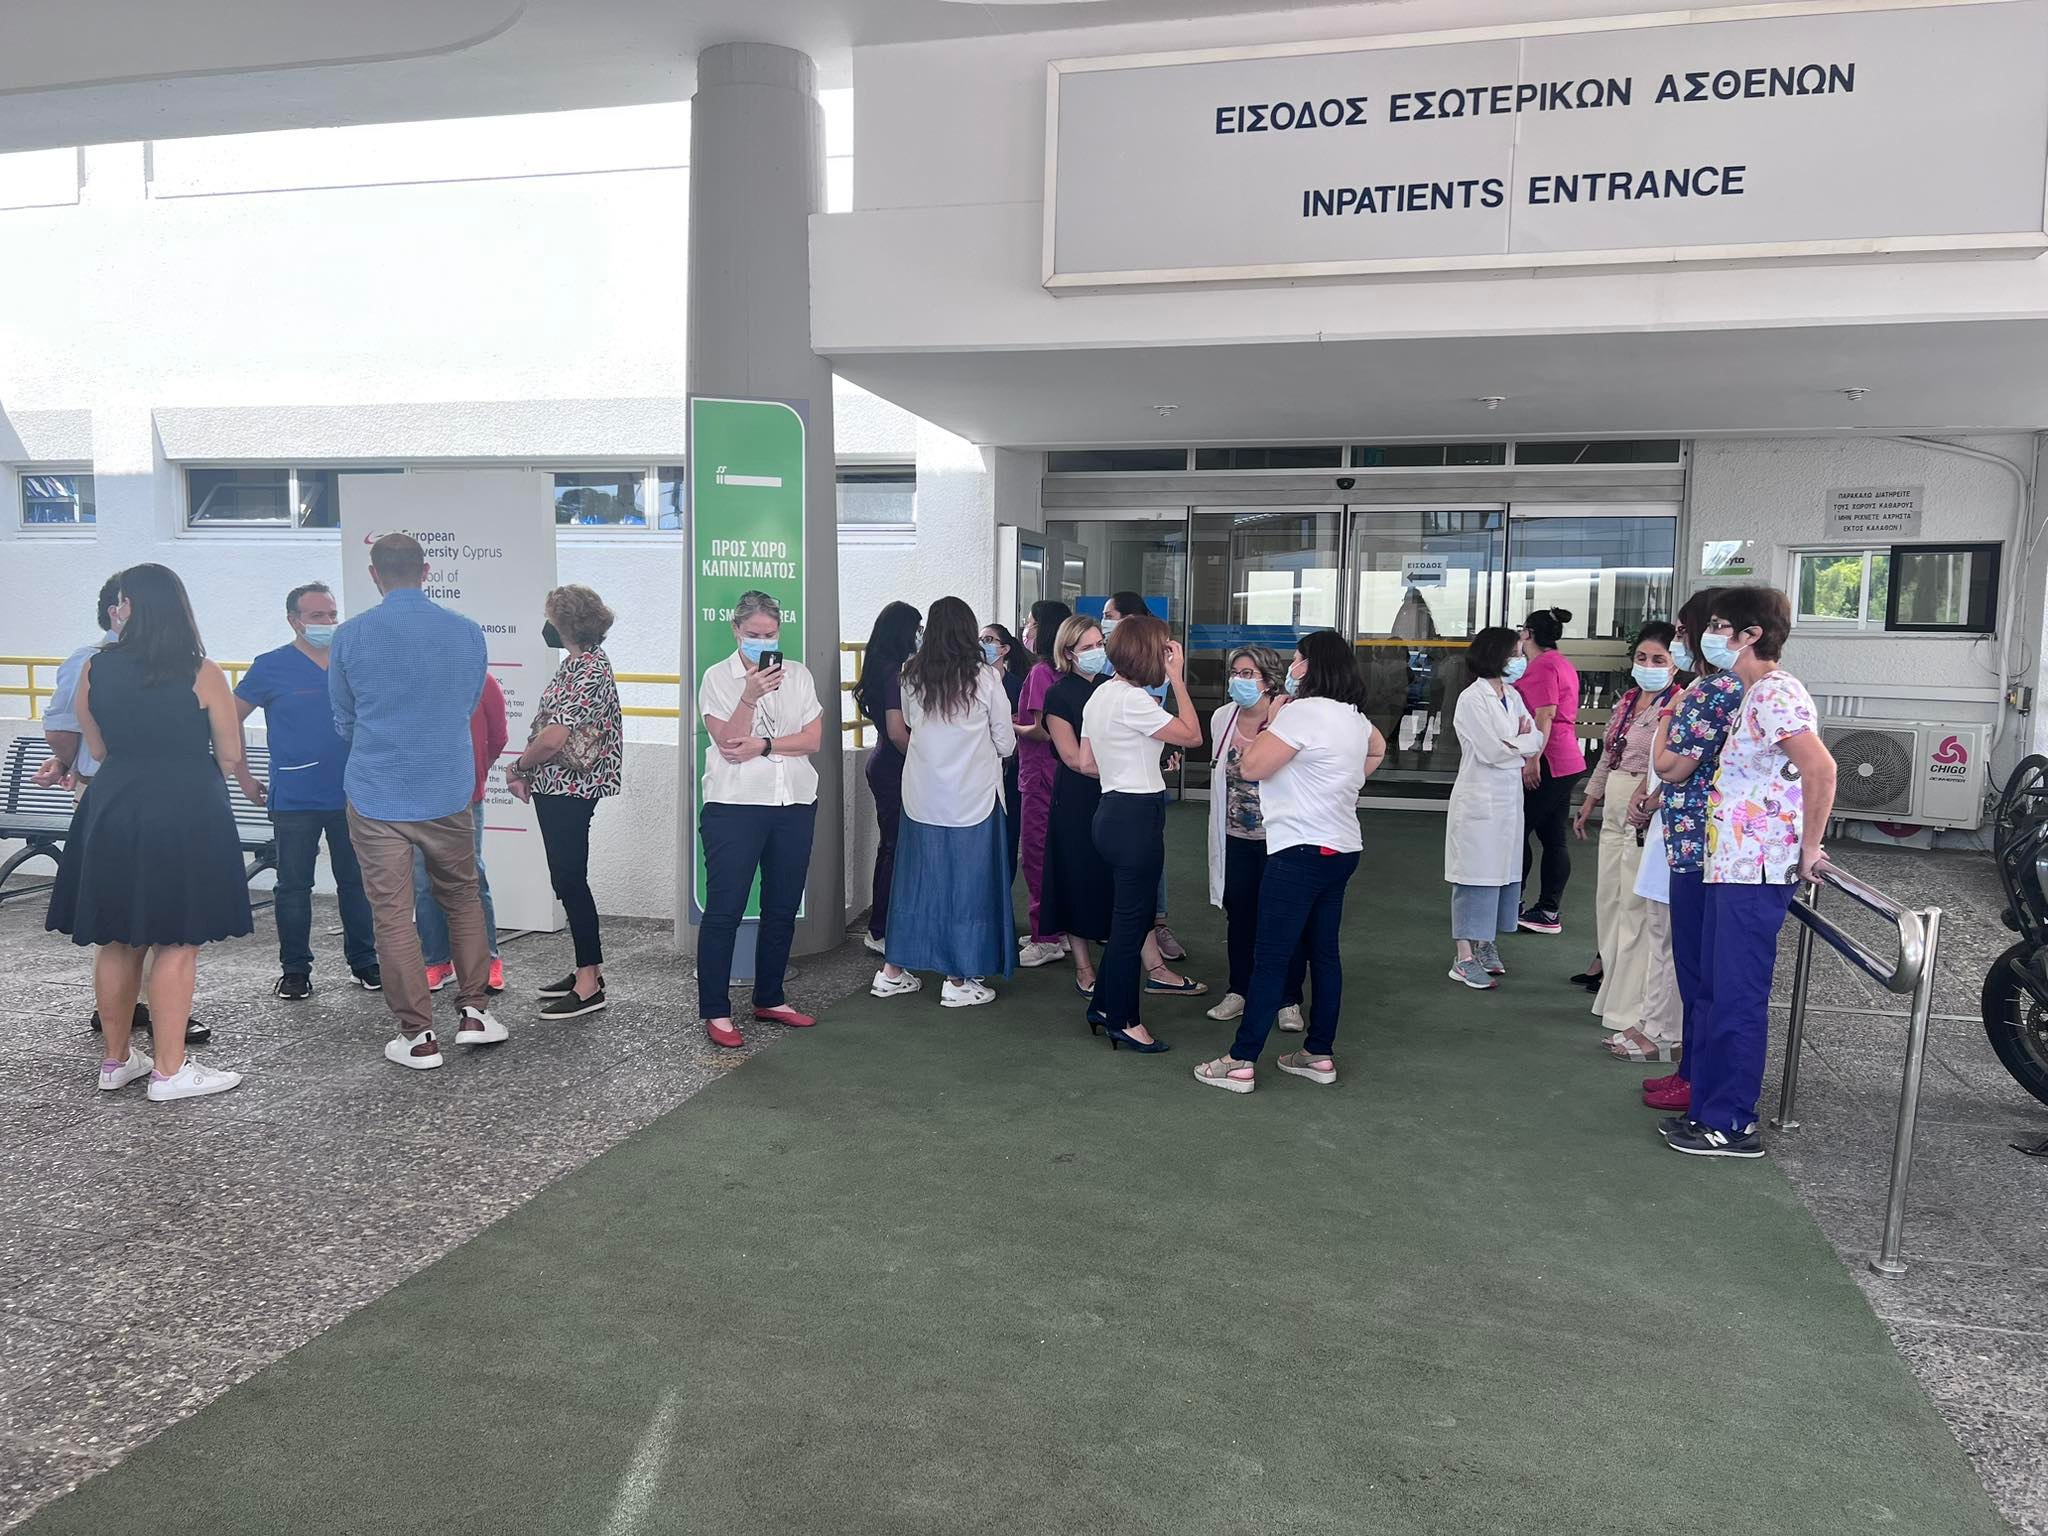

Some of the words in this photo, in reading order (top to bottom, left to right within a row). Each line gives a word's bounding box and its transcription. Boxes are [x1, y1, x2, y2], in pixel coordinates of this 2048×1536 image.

[1216, 97, 1367, 134] ΕΙΣΟΔΟΣ
[1390, 78, 1631, 122] ΕΣΩΤΕΡΙΚΩΝ
[1655, 63, 1854, 103] ΑΣΘΕΝΩΝ
[1304, 179, 1503, 217] INPATIENTS
[1529, 166, 1745, 204] ENTRANCE
[424, 546, 459, 560] versity
[463, 545, 503, 560] Cyprus
[712, 540, 747, 557] ΠΡΟΣ
[751, 541, 786, 559] ΧΩΡΟ
[427, 569, 444, 583] ool
[447, 569, 459, 583] of
[702, 560, 796, 579] ΚΑΠΝΙΣΜΑΤΟΣ
[424, 586, 460, 599] dicine
[702, 607, 716, 621] TO
[779, 610, 796, 623] REA
[482, 624, 506, 634] ARIOS
[508, 625, 517, 634] III
[1930, 764, 1967, 774] CHIGO
[485, 787, 512, 795] ropean
